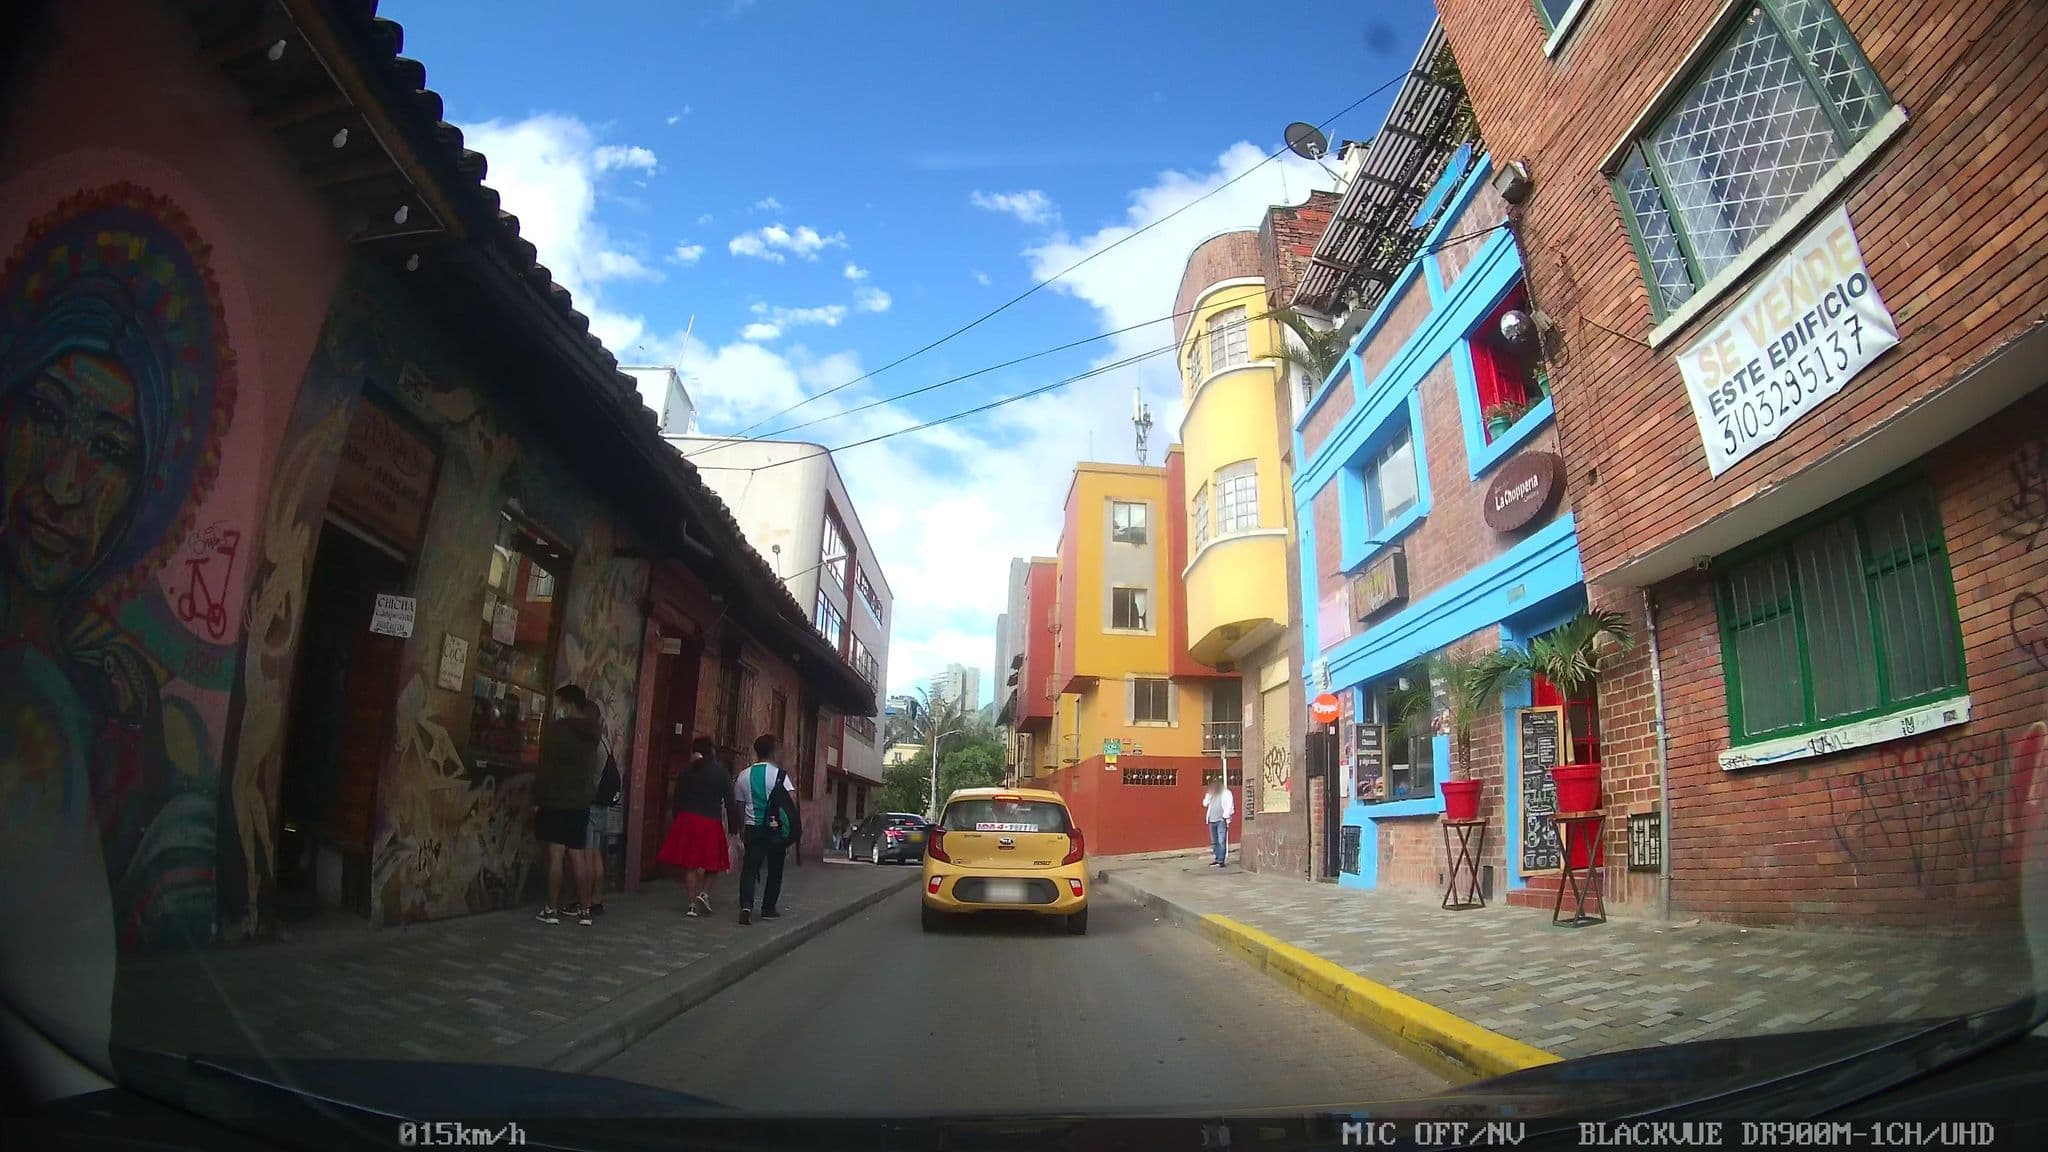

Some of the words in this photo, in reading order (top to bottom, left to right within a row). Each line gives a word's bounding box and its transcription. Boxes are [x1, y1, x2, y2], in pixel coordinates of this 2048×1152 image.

[1697, 327, 1742, 391] SE
[1740, 225, 1862, 349] VENDE
[1708, 357, 1765, 415] ESTE
[1767, 272, 1868, 370] EDIFICIO
[1717, 312, 1864, 456] 3103295137
